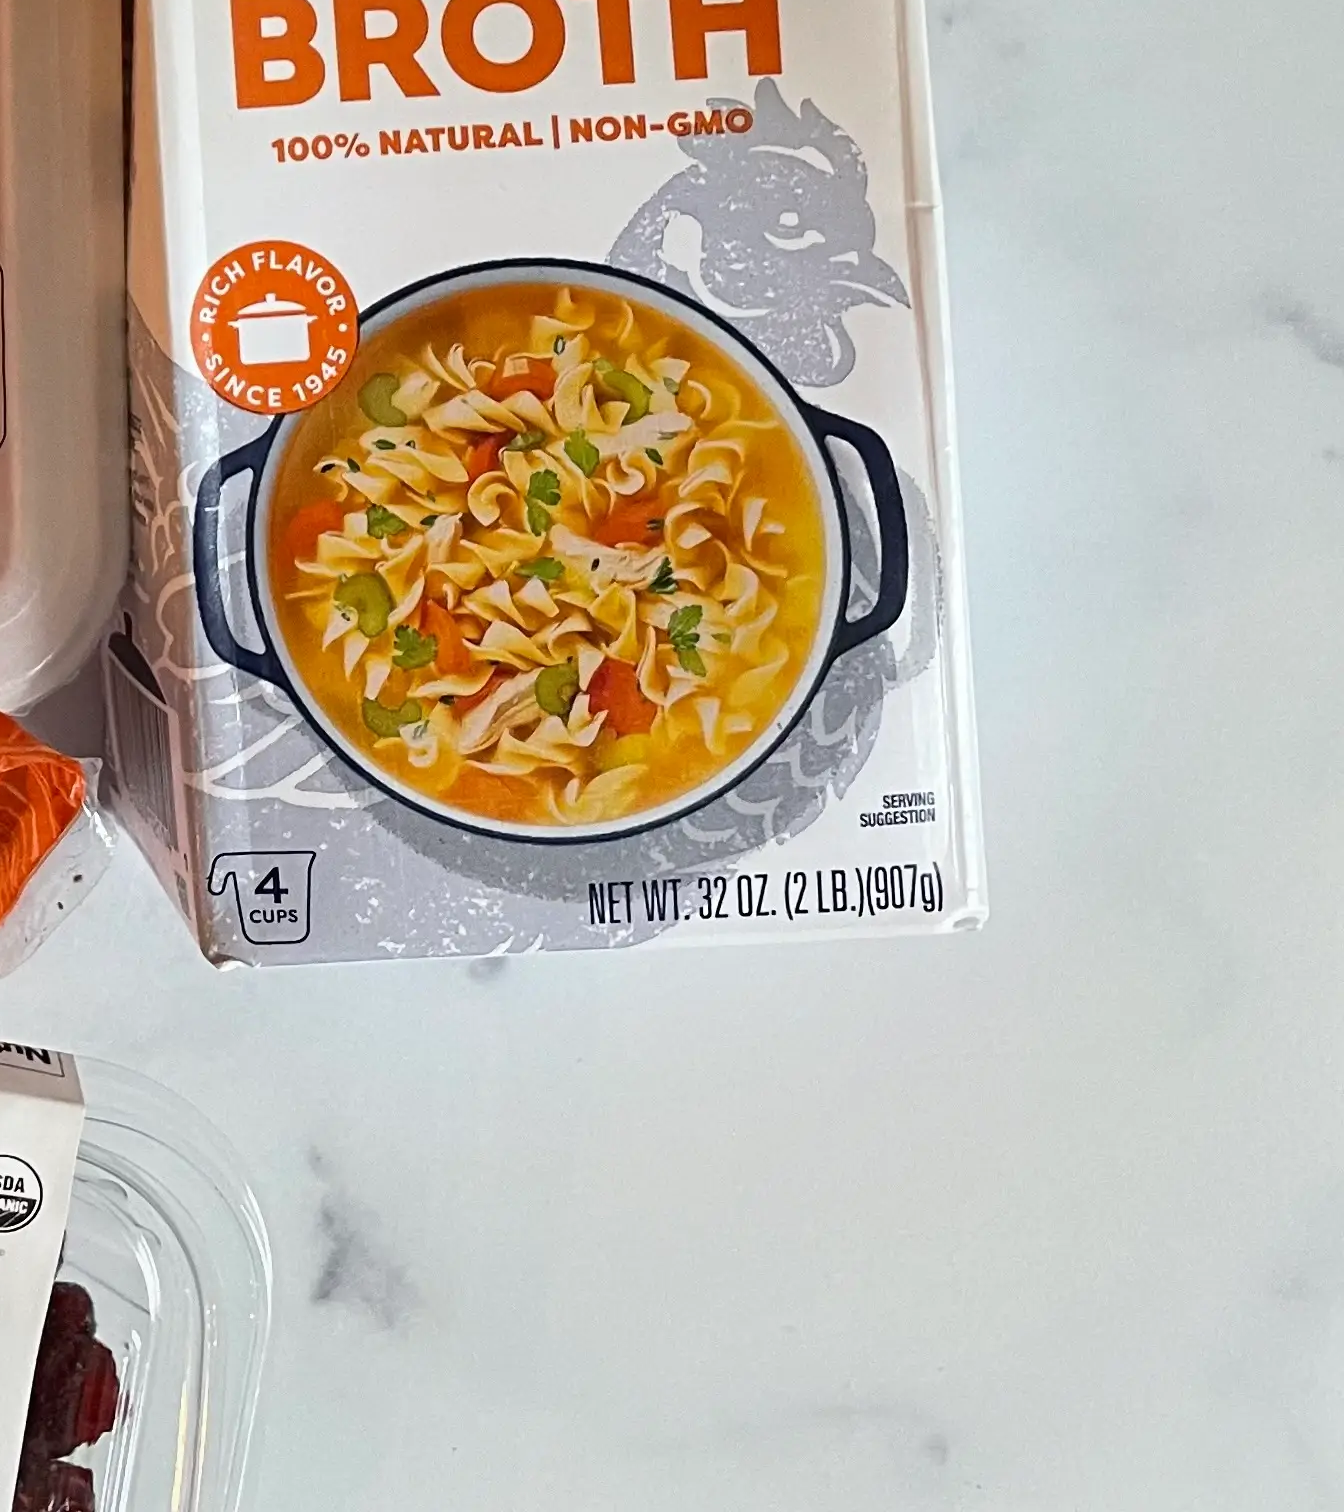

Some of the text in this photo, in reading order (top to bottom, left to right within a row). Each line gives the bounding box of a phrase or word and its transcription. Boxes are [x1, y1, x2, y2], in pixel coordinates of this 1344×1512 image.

[271, 108, 754, 164] 100% NATURAL NON-GMO
[199, 250, 347, 324] RICH FLAVOR
[206, 346, 347, 407] SINCE 1945
[860, 808, 936, 828] SUGGESTION
[882, 791, 936, 809] SERVING
[255, 867, 289, 904] 4
[588, 874, 777, 925] NET WT. 32 OZ.
[249, 907, 299, 926] CUPS
